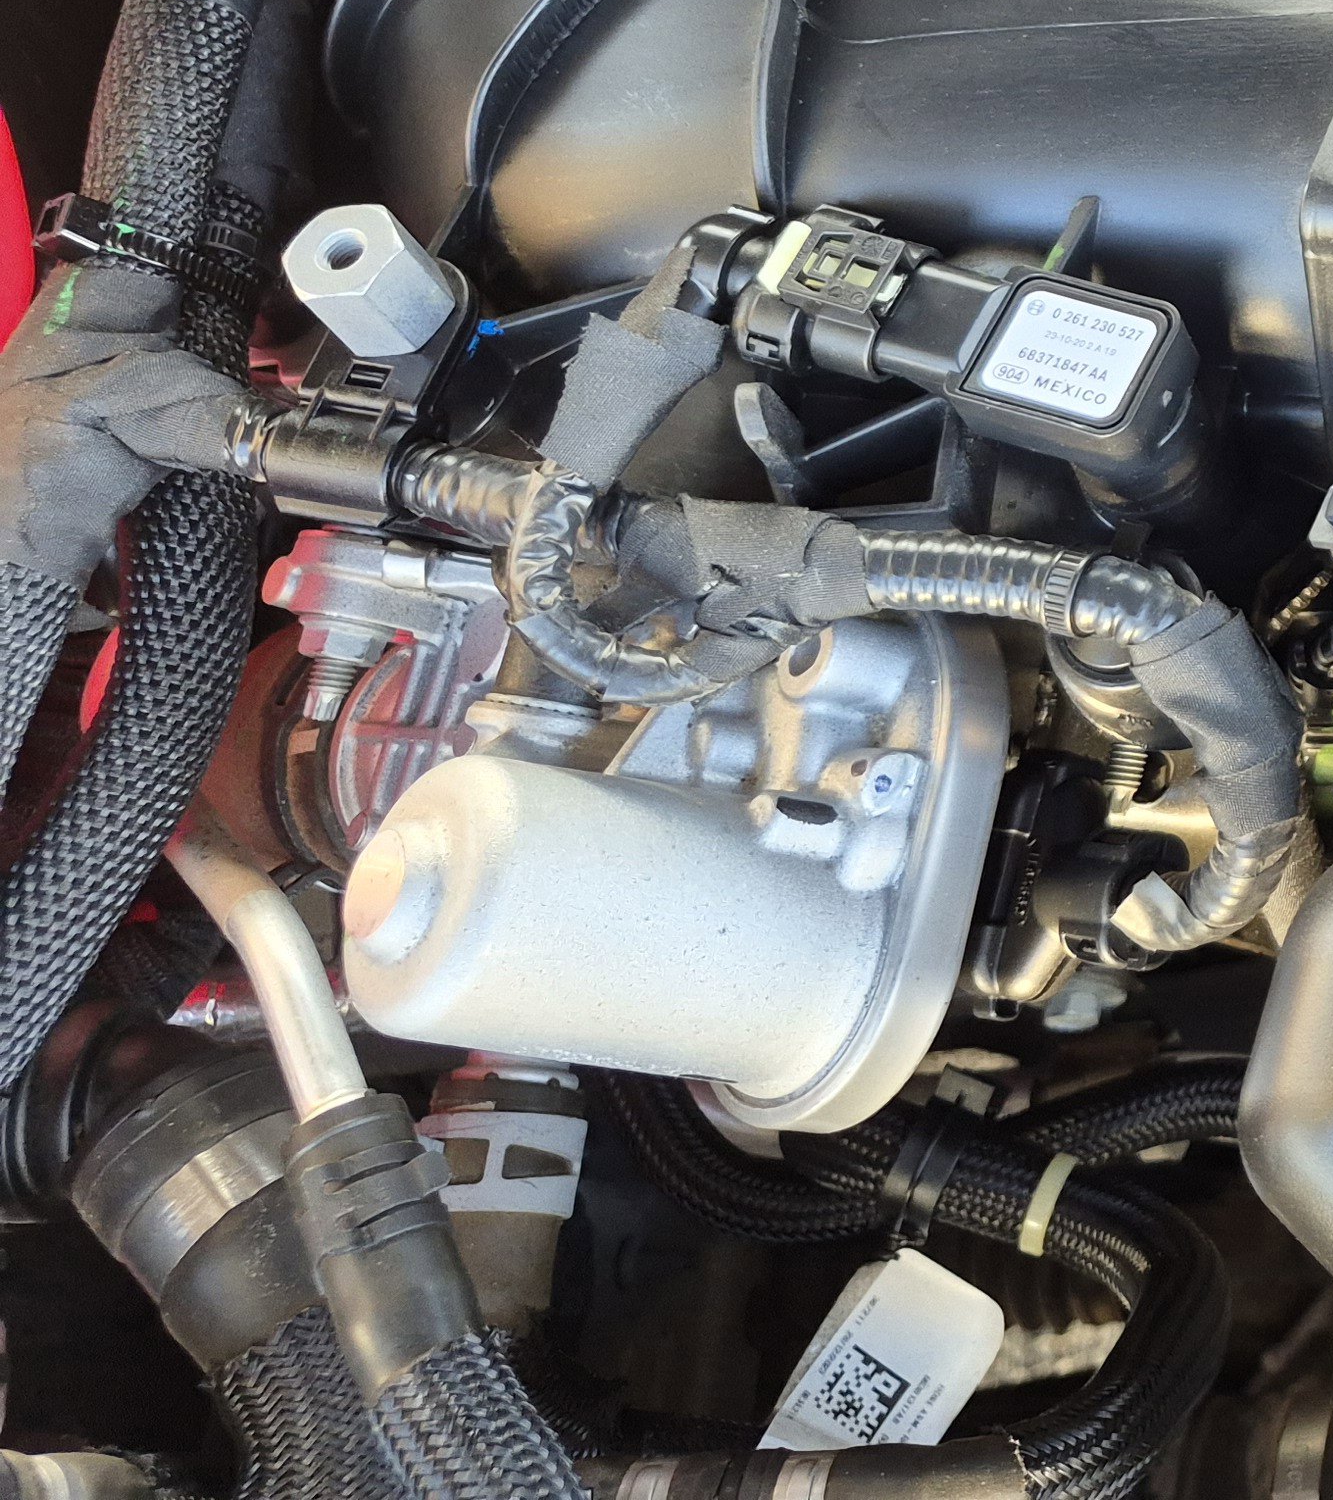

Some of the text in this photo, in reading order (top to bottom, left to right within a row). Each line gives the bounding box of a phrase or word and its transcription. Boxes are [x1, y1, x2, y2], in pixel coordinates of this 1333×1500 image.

[1063, 310, 1089, 328] 261
[1091, 318, 1117, 334] 230
[1118, 325, 1145, 342] 527
[997, 364, 1108, 405] 904 MEXICO
